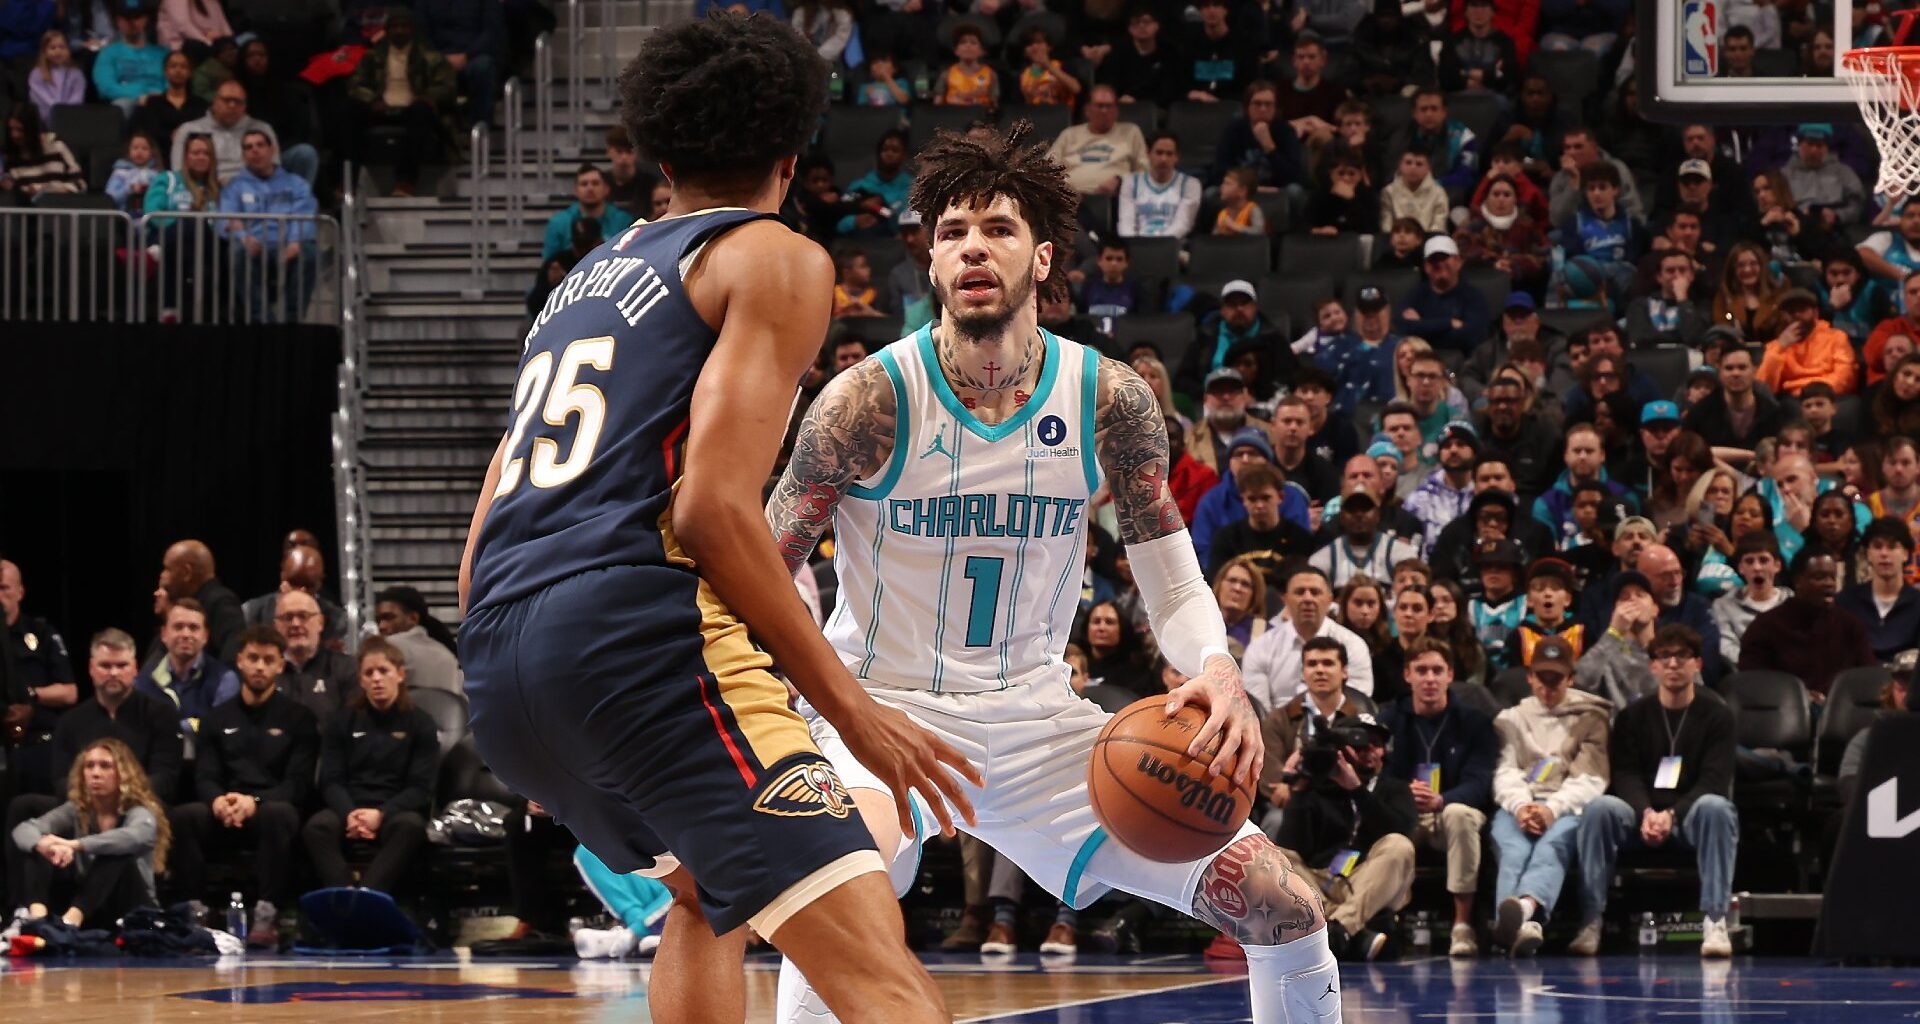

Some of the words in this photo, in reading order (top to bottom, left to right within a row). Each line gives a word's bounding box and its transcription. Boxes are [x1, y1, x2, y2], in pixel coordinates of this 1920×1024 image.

[615, 265, 670, 327] III
[491, 335, 616, 504] 25
[1027, 449, 1049, 458] Judi
[1049, 446, 1080, 458] Health
[889, 493, 1086, 538] CHARLOTTE
[963, 555, 1005, 648] 1
[1136, 751, 1237, 826] Wilson
